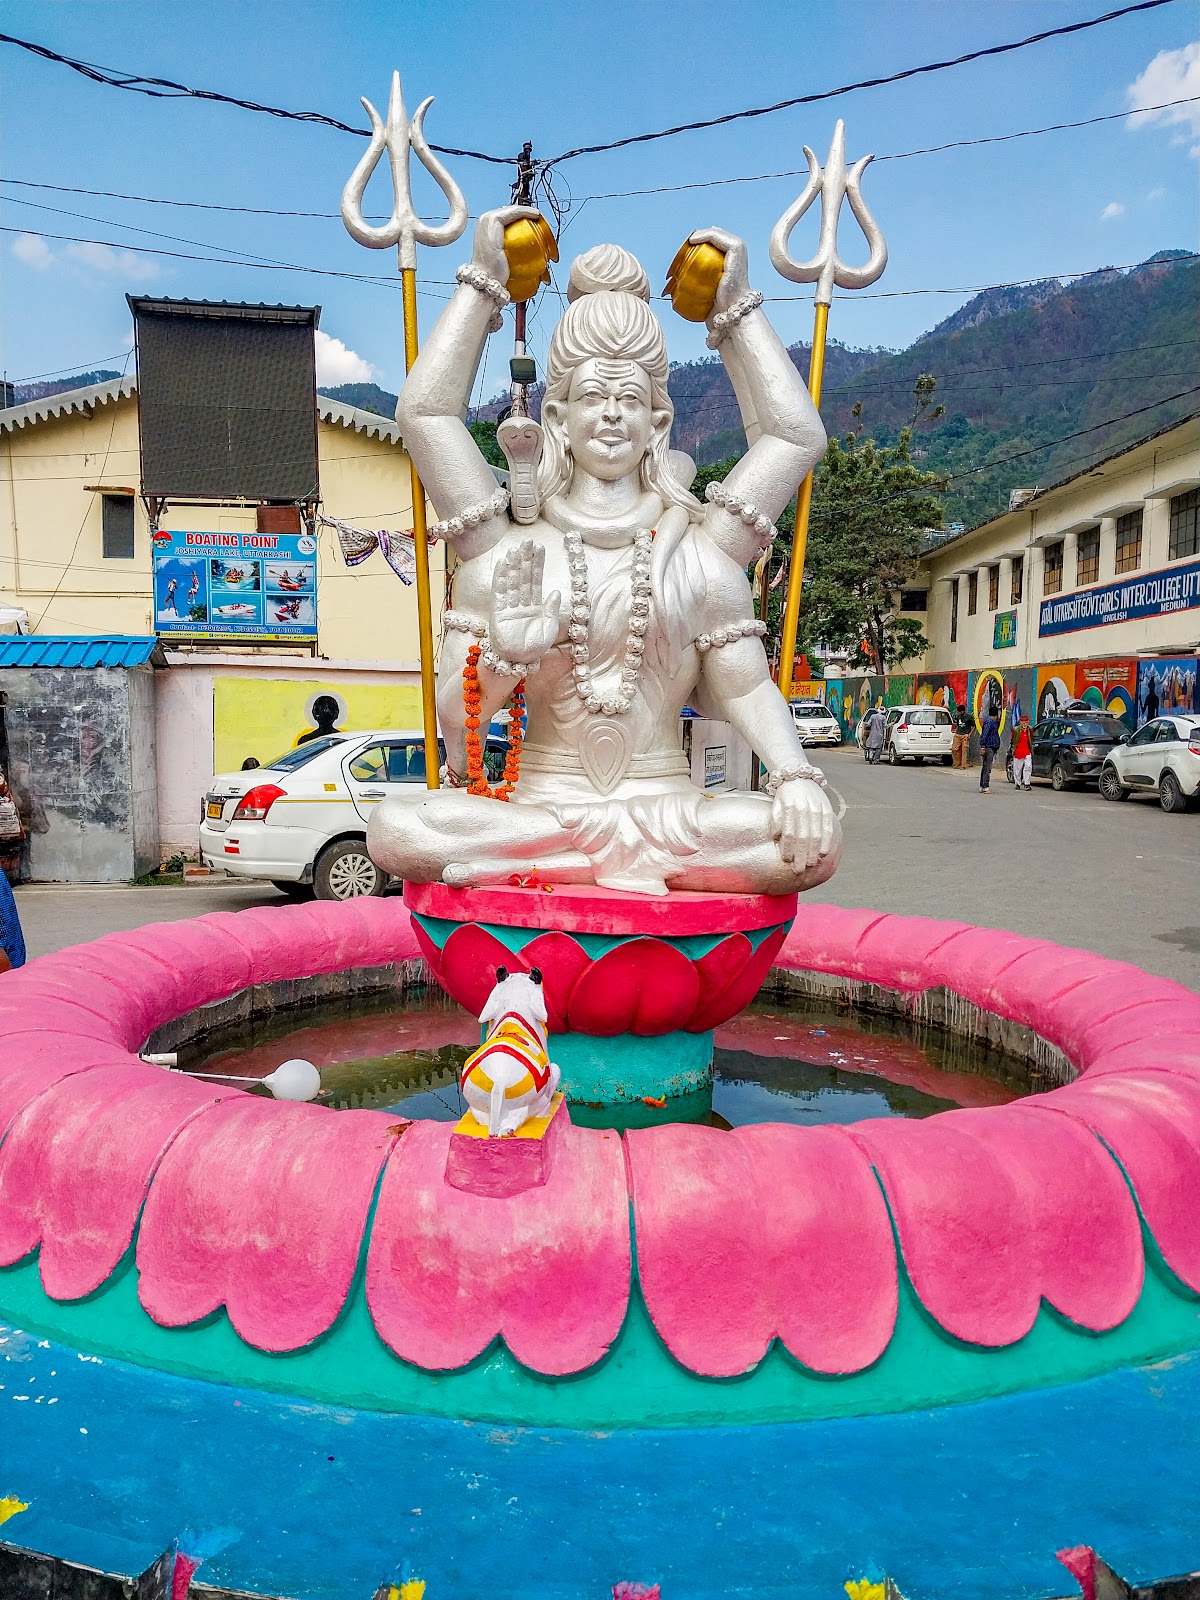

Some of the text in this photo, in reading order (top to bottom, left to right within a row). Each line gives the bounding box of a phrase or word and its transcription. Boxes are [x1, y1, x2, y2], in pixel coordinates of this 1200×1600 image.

[186, 533, 279, 548] BOATING POINT
[175, 547, 292, 559] JOSHIYARA LAKE, UTTARKASHI
[1120, 583, 1146, 609] INTER
[1145, 575, 1182, 605] COLLEGE
